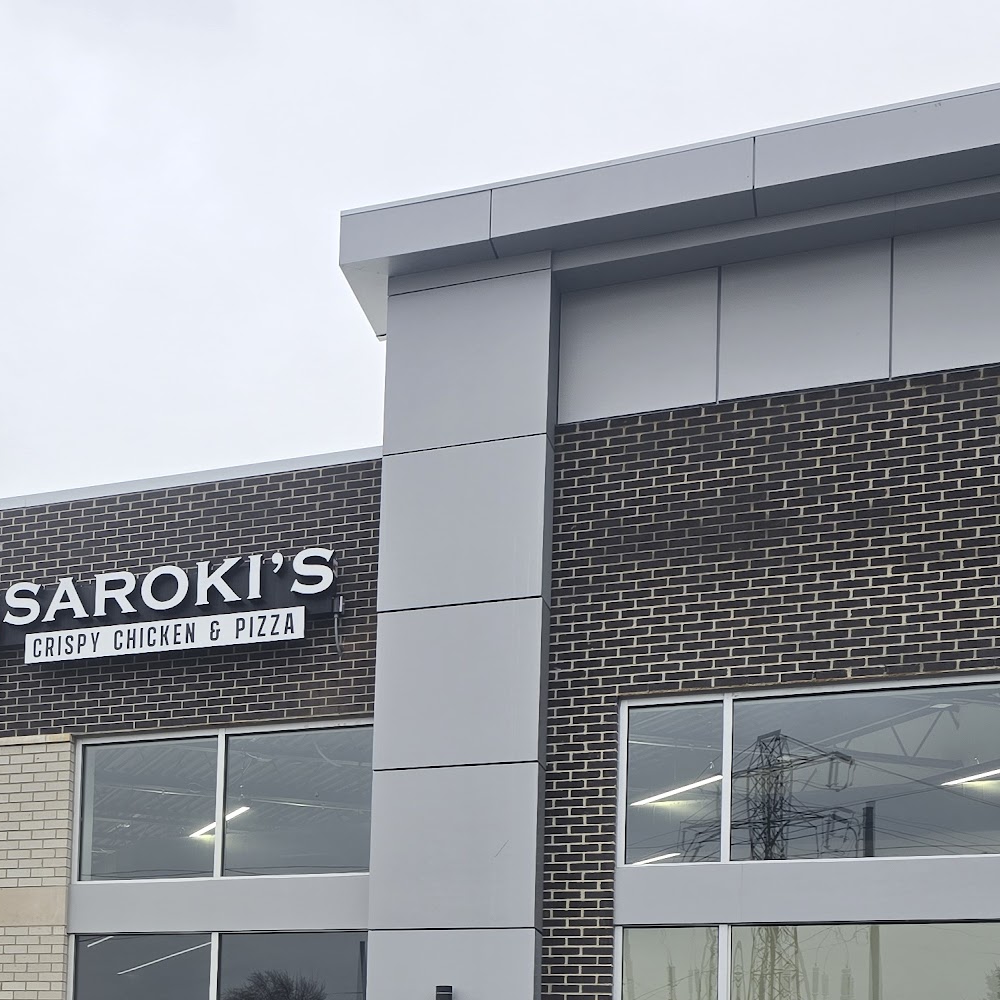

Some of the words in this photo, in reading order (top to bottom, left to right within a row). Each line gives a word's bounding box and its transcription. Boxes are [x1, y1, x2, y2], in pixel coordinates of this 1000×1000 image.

[3, 548, 335, 626] SAROKI'S
[32, 631, 101, 658] CRISPY
[113, 622, 196, 651] CHICKEN
[209, 620, 221, 641] &
[235, 611, 296, 640] PIZZA
